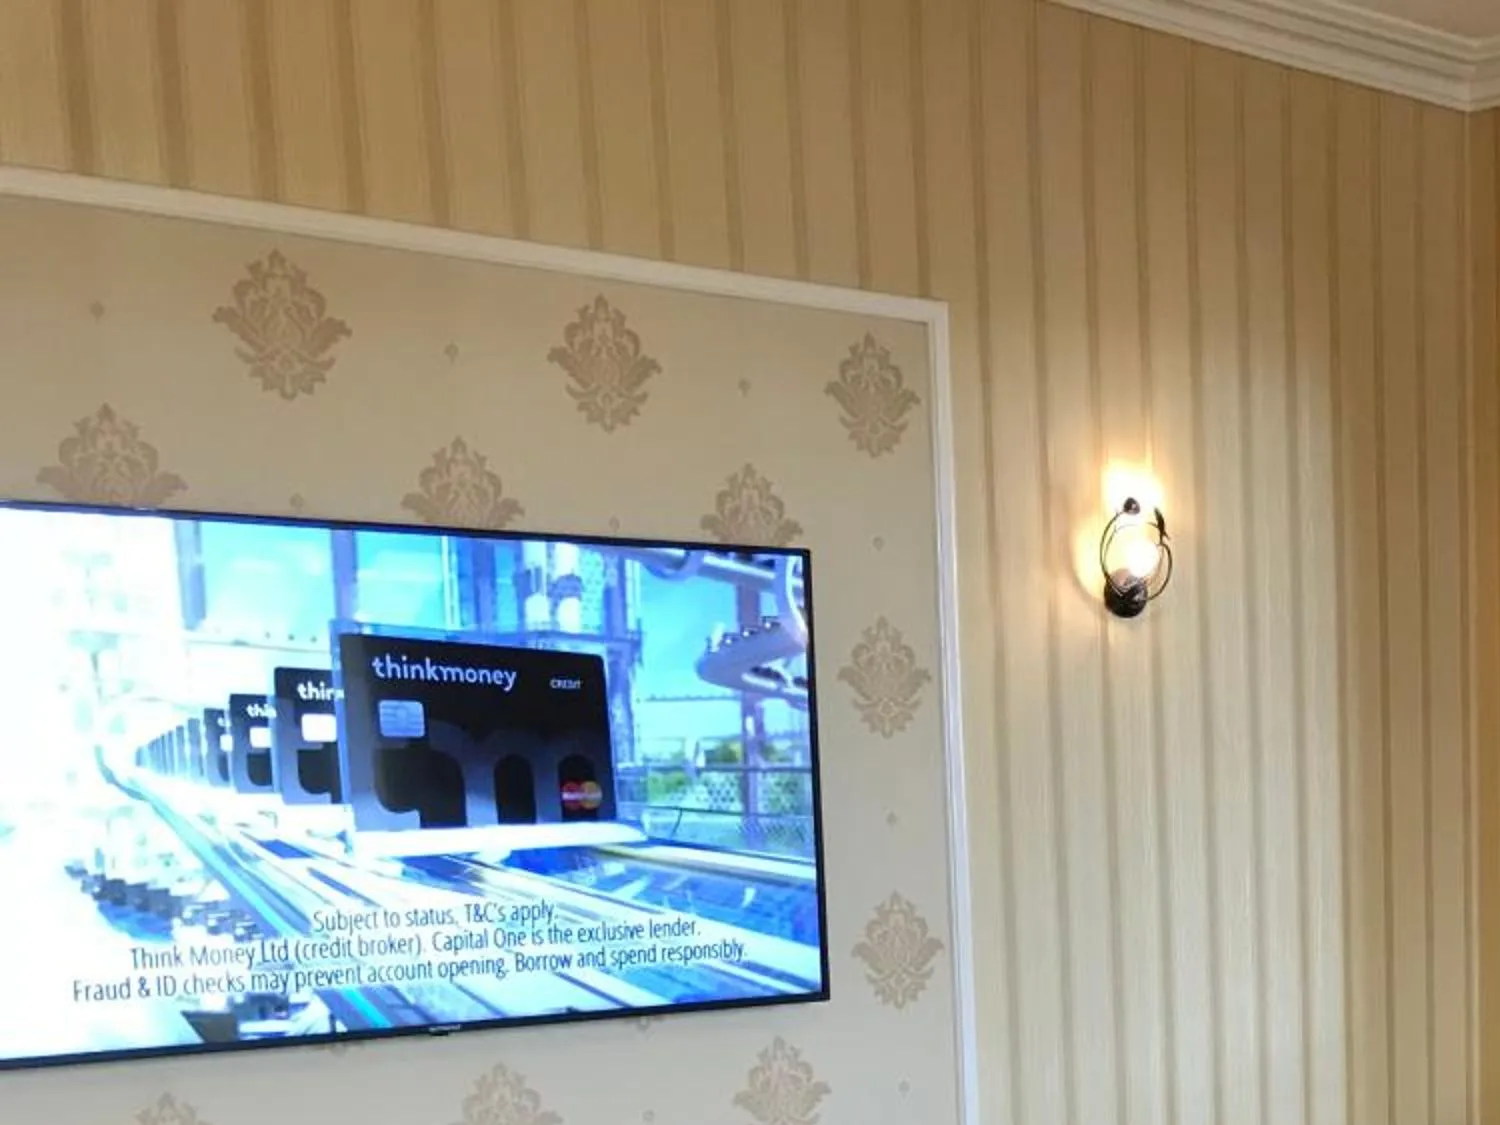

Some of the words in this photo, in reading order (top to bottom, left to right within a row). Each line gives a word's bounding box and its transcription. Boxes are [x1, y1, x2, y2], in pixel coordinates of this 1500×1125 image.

[372, 653, 517, 693] thinkmoney
[129, 946, 183, 970] Think
[190, 944, 255, 973] Money
[261, 938, 289, 963] Ltd
[294, 936, 351, 965] (credit
[432, 928, 489, 958] Capital
[494, 927, 526, 949] One
[531, 926, 545, 946] is
[549, 924, 574, 945] the
[577, 919, 646, 944] exclusive
[649, 916, 702, 938] lender.
[313, 910, 379, 938] Subject
[384, 909, 401, 930] to
[464, 903, 506, 924] T&C's
[73, 976, 131, 1003] Fraud
[138, 976, 151, 997] &
[157, 973, 177, 997] ID
[183, 969, 246, 996] checks
[251, 970, 289, 994] may
[294, 964, 363, 996] prevent
[367, 959, 433, 983] account
[438, 955, 509, 984] opening.
[515, 950, 573, 974] Borrow
[577, 948, 607, 969] and
[610, 944, 657, 971] spend
[661, 938, 748, 964] responsibly.
